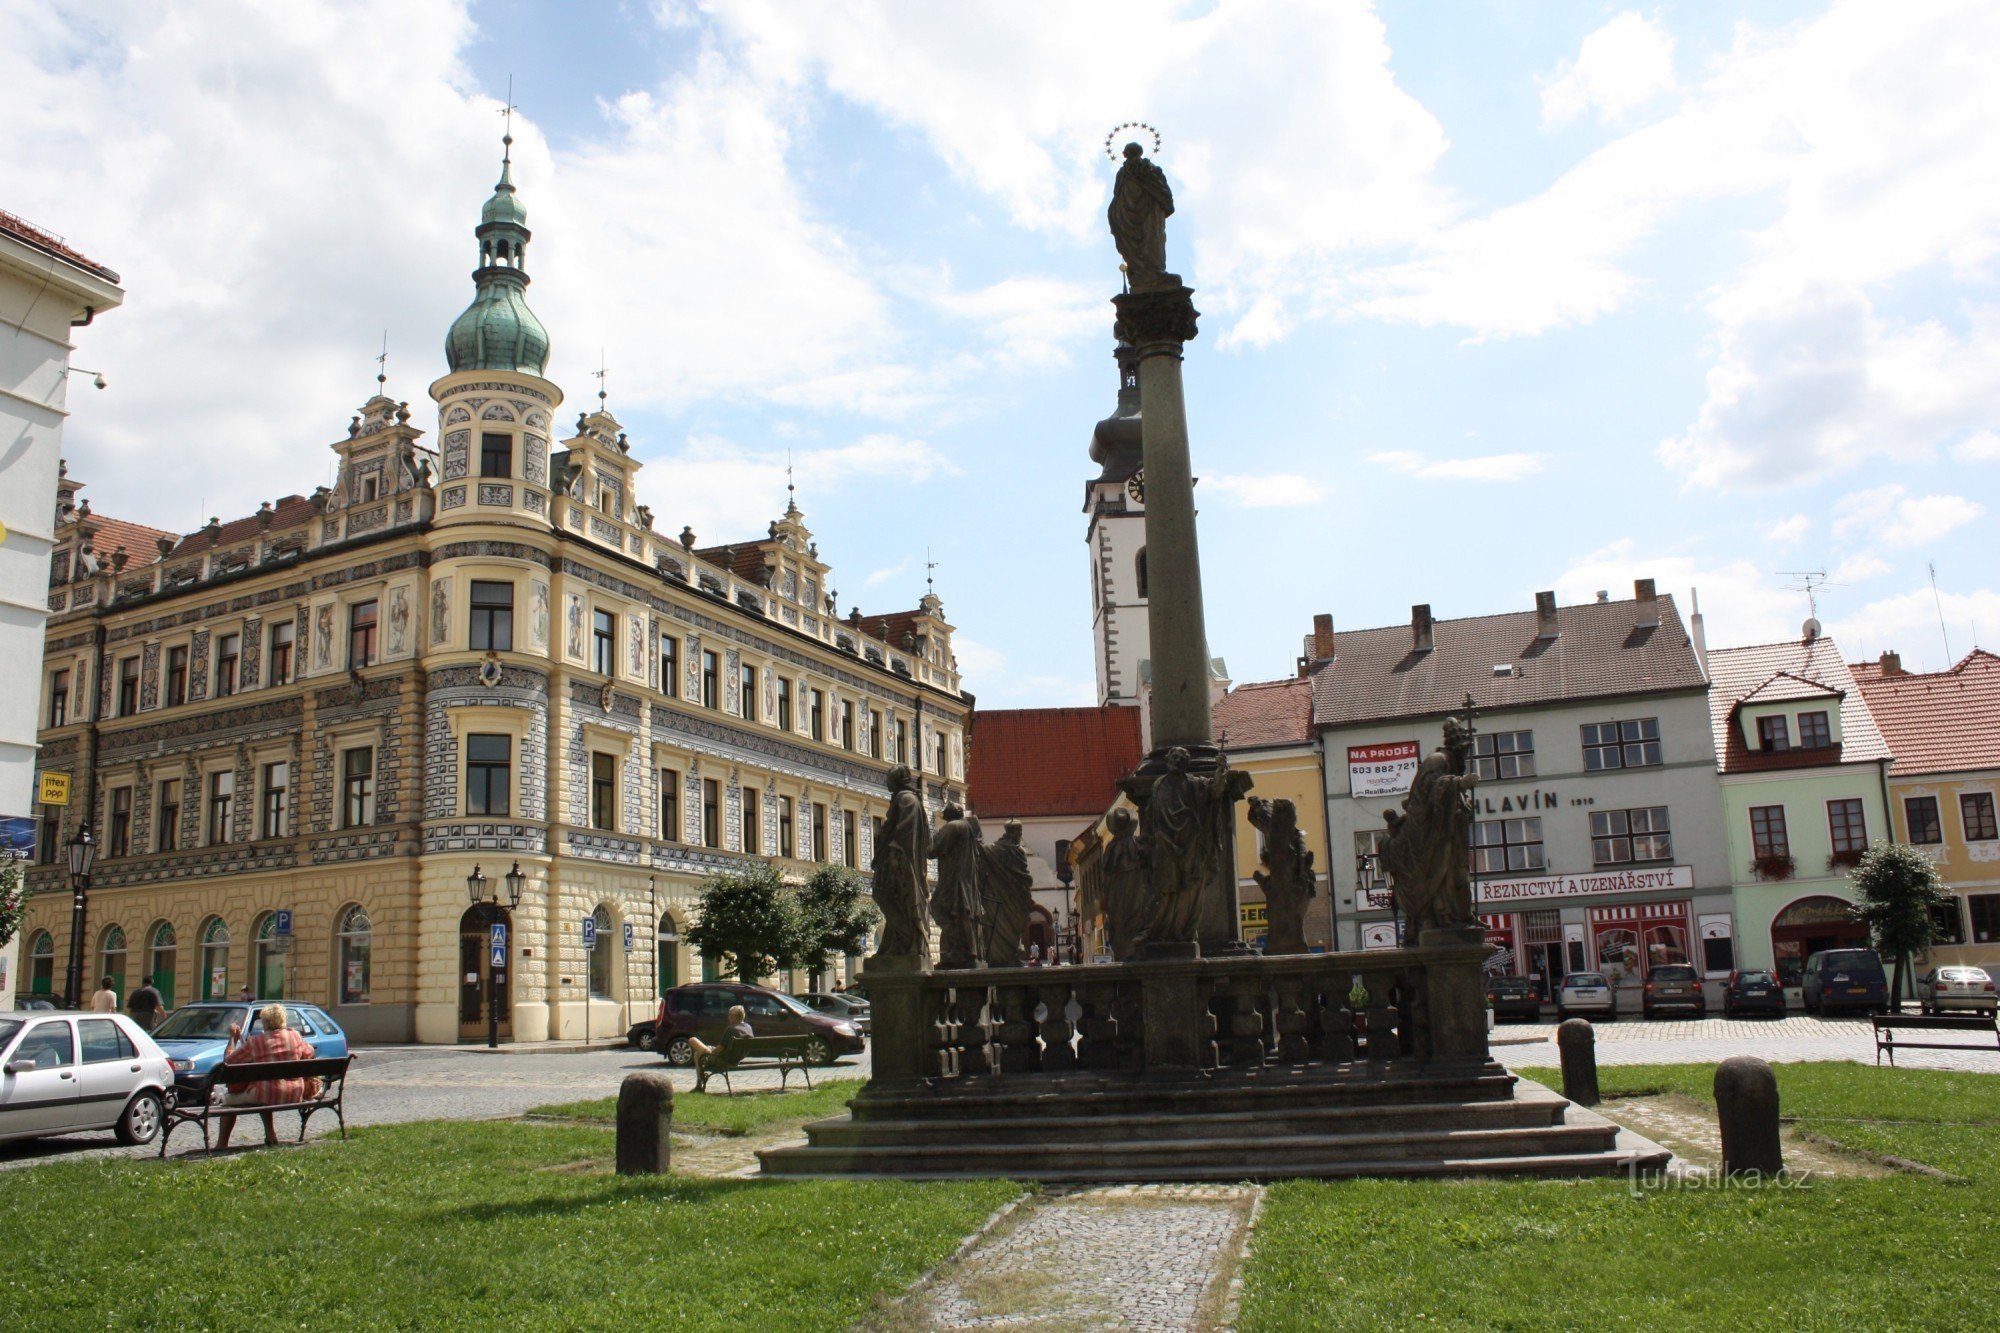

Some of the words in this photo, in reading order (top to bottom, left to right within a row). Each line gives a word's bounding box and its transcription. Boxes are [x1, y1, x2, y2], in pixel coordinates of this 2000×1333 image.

[1350, 750, 1367, 759] NA
[1370, 745, 1416, 758] PRODEJ
[1352, 766, 1372, 774] 603
[1375, 765, 1394, 773] 882
[1397, 762, 1415, 771] 721
[45, 789, 63, 799] ppp
[1483, 877, 1565, 900] ŘEZNICTVÍ
[1569, 880, 1579, 893] A
[1581, 869, 1675, 892] UZENÁŘSTVÍ
[279, 912, 289, 928] P
[585, 921, 594, 937] P
[624, 925, 631, 940] P
